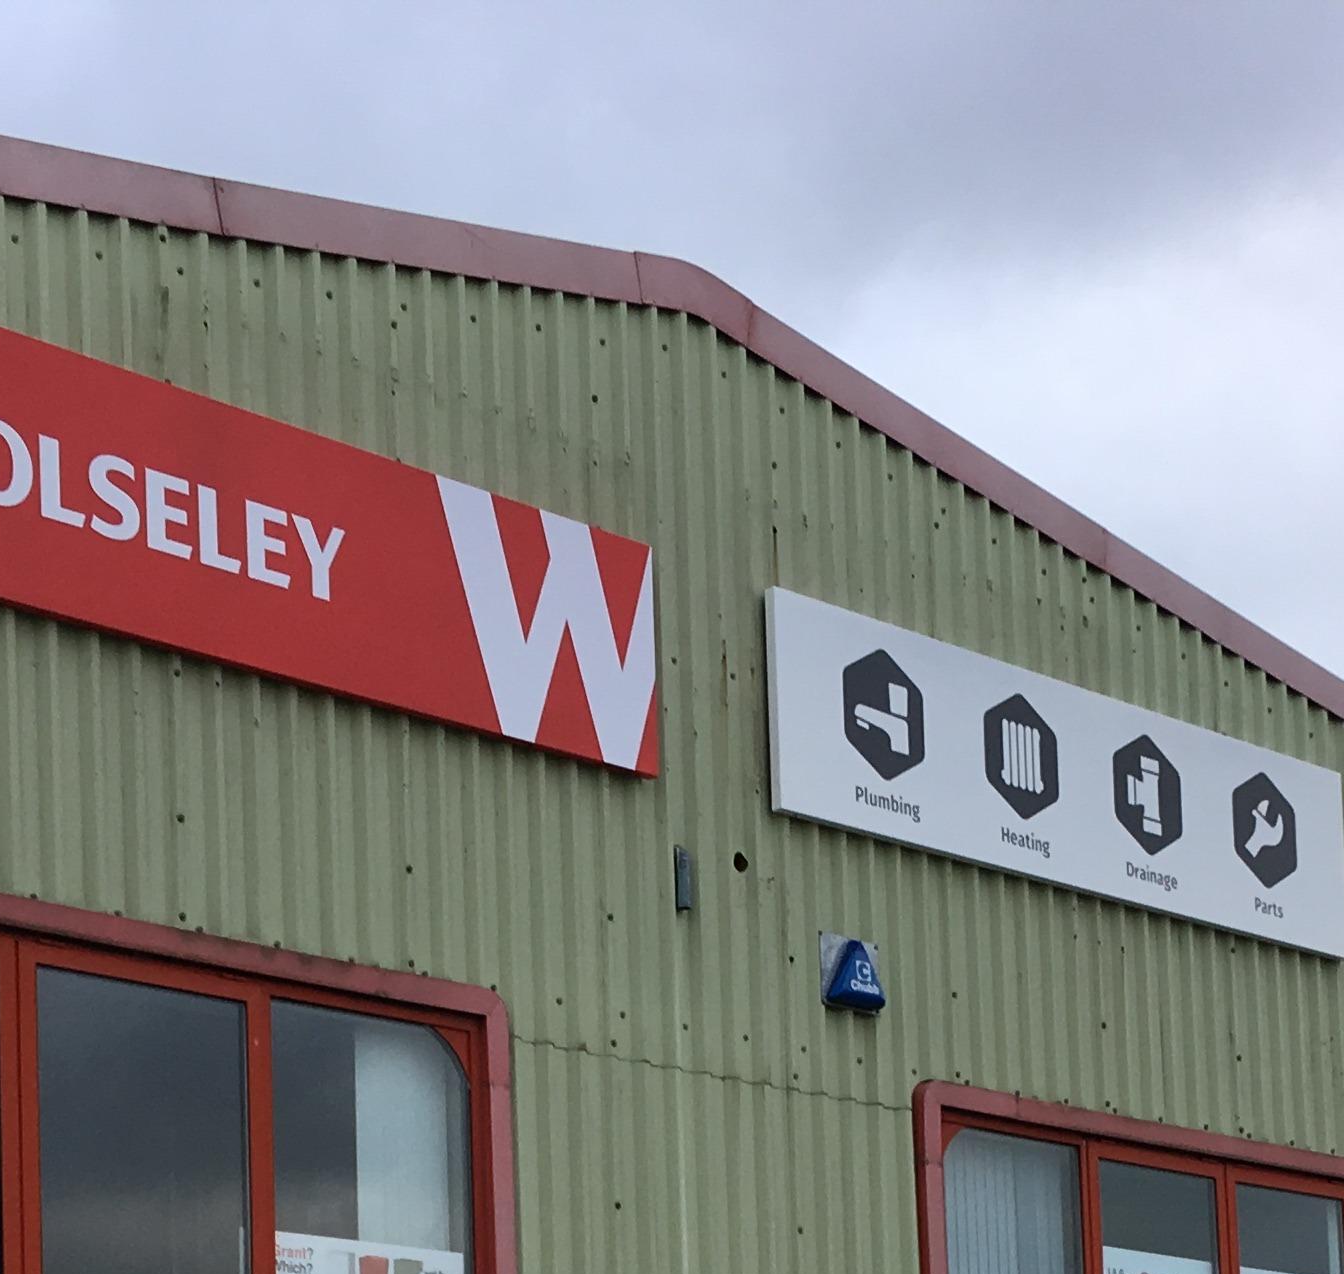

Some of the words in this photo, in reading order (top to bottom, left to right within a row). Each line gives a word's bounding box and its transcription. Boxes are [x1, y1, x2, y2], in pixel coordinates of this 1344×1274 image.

[433, 473, 657, 773] W
[854, 785, 921, 823] Plumbing
[1000, 826, 1051, 859] Heating
[1125, 860, 1178, 892] Drainage
[1254, 896, 1284, 919] Parts
